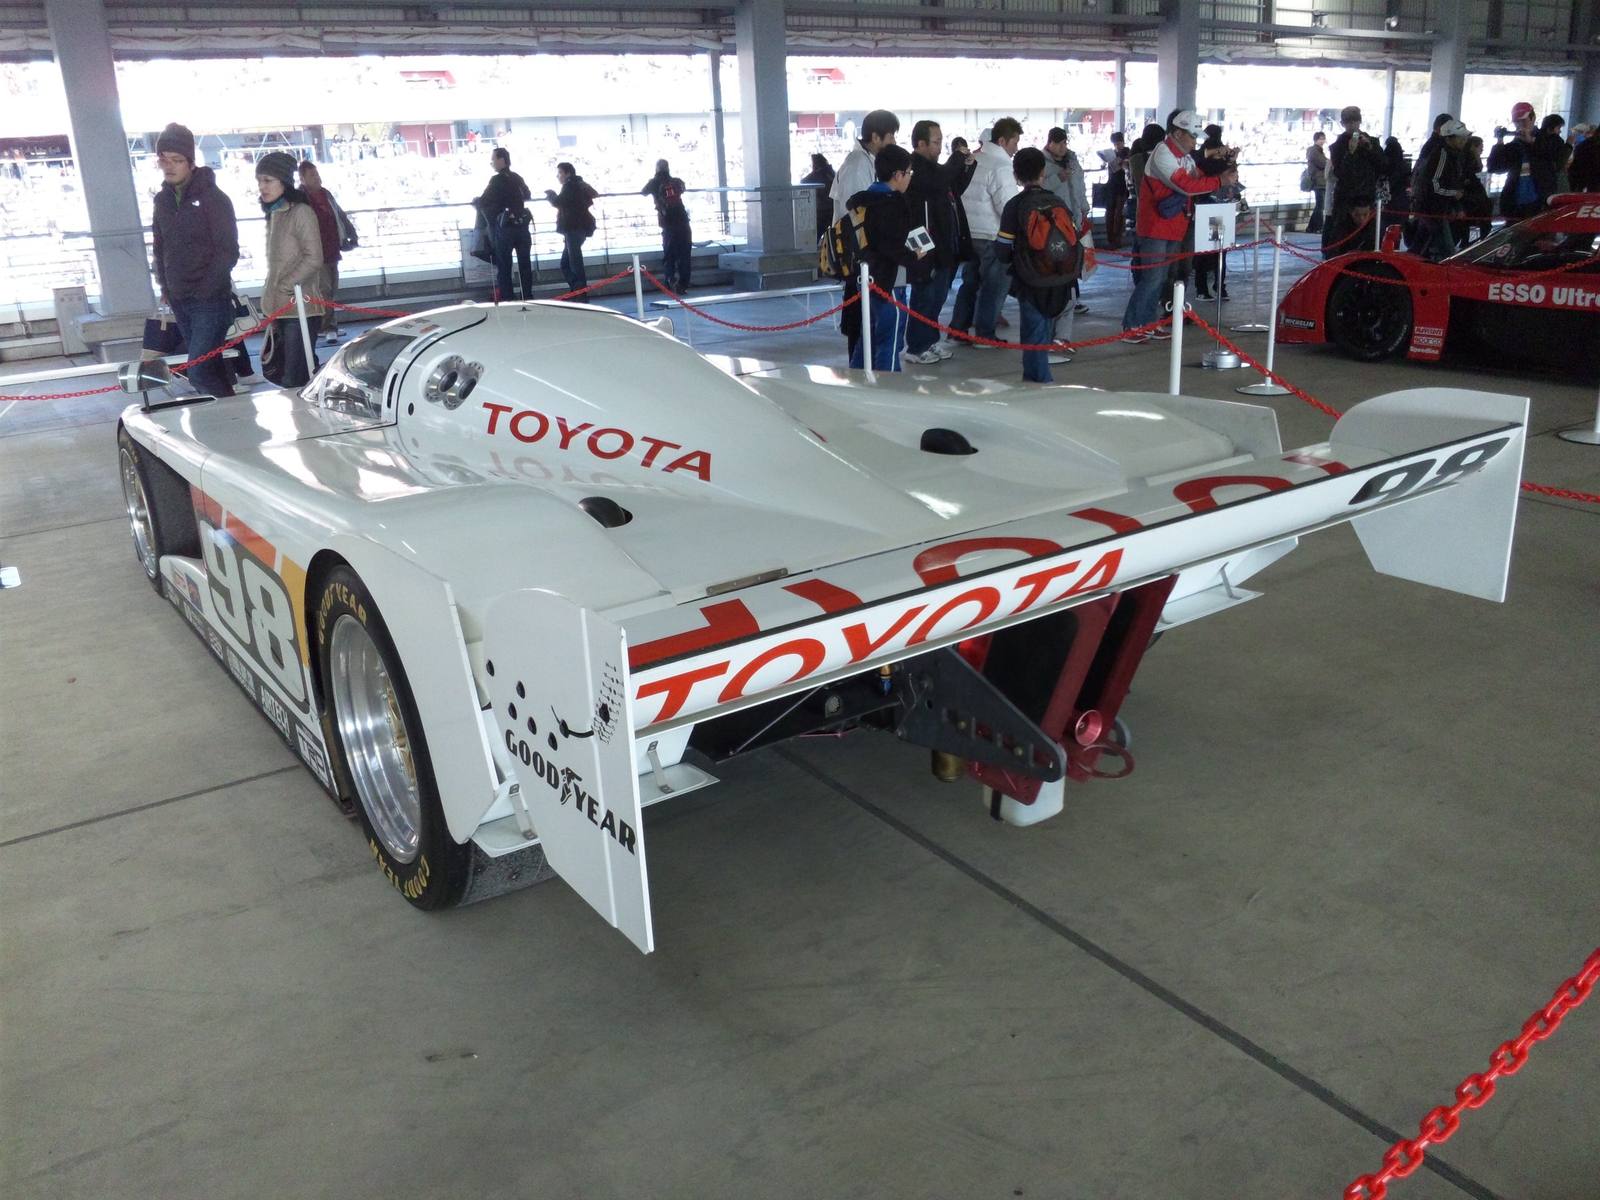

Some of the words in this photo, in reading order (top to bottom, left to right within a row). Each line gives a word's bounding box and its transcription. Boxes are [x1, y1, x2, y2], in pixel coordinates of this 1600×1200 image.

[1488, 283, 1546, 303] ESSO
[482, 402, 712, 482] TOYOTA
[200, 519, 308, 708] 98
[636, 548, 1124, 724] TOYOTA
[505, 728, 637, 856] GOODYEAR
